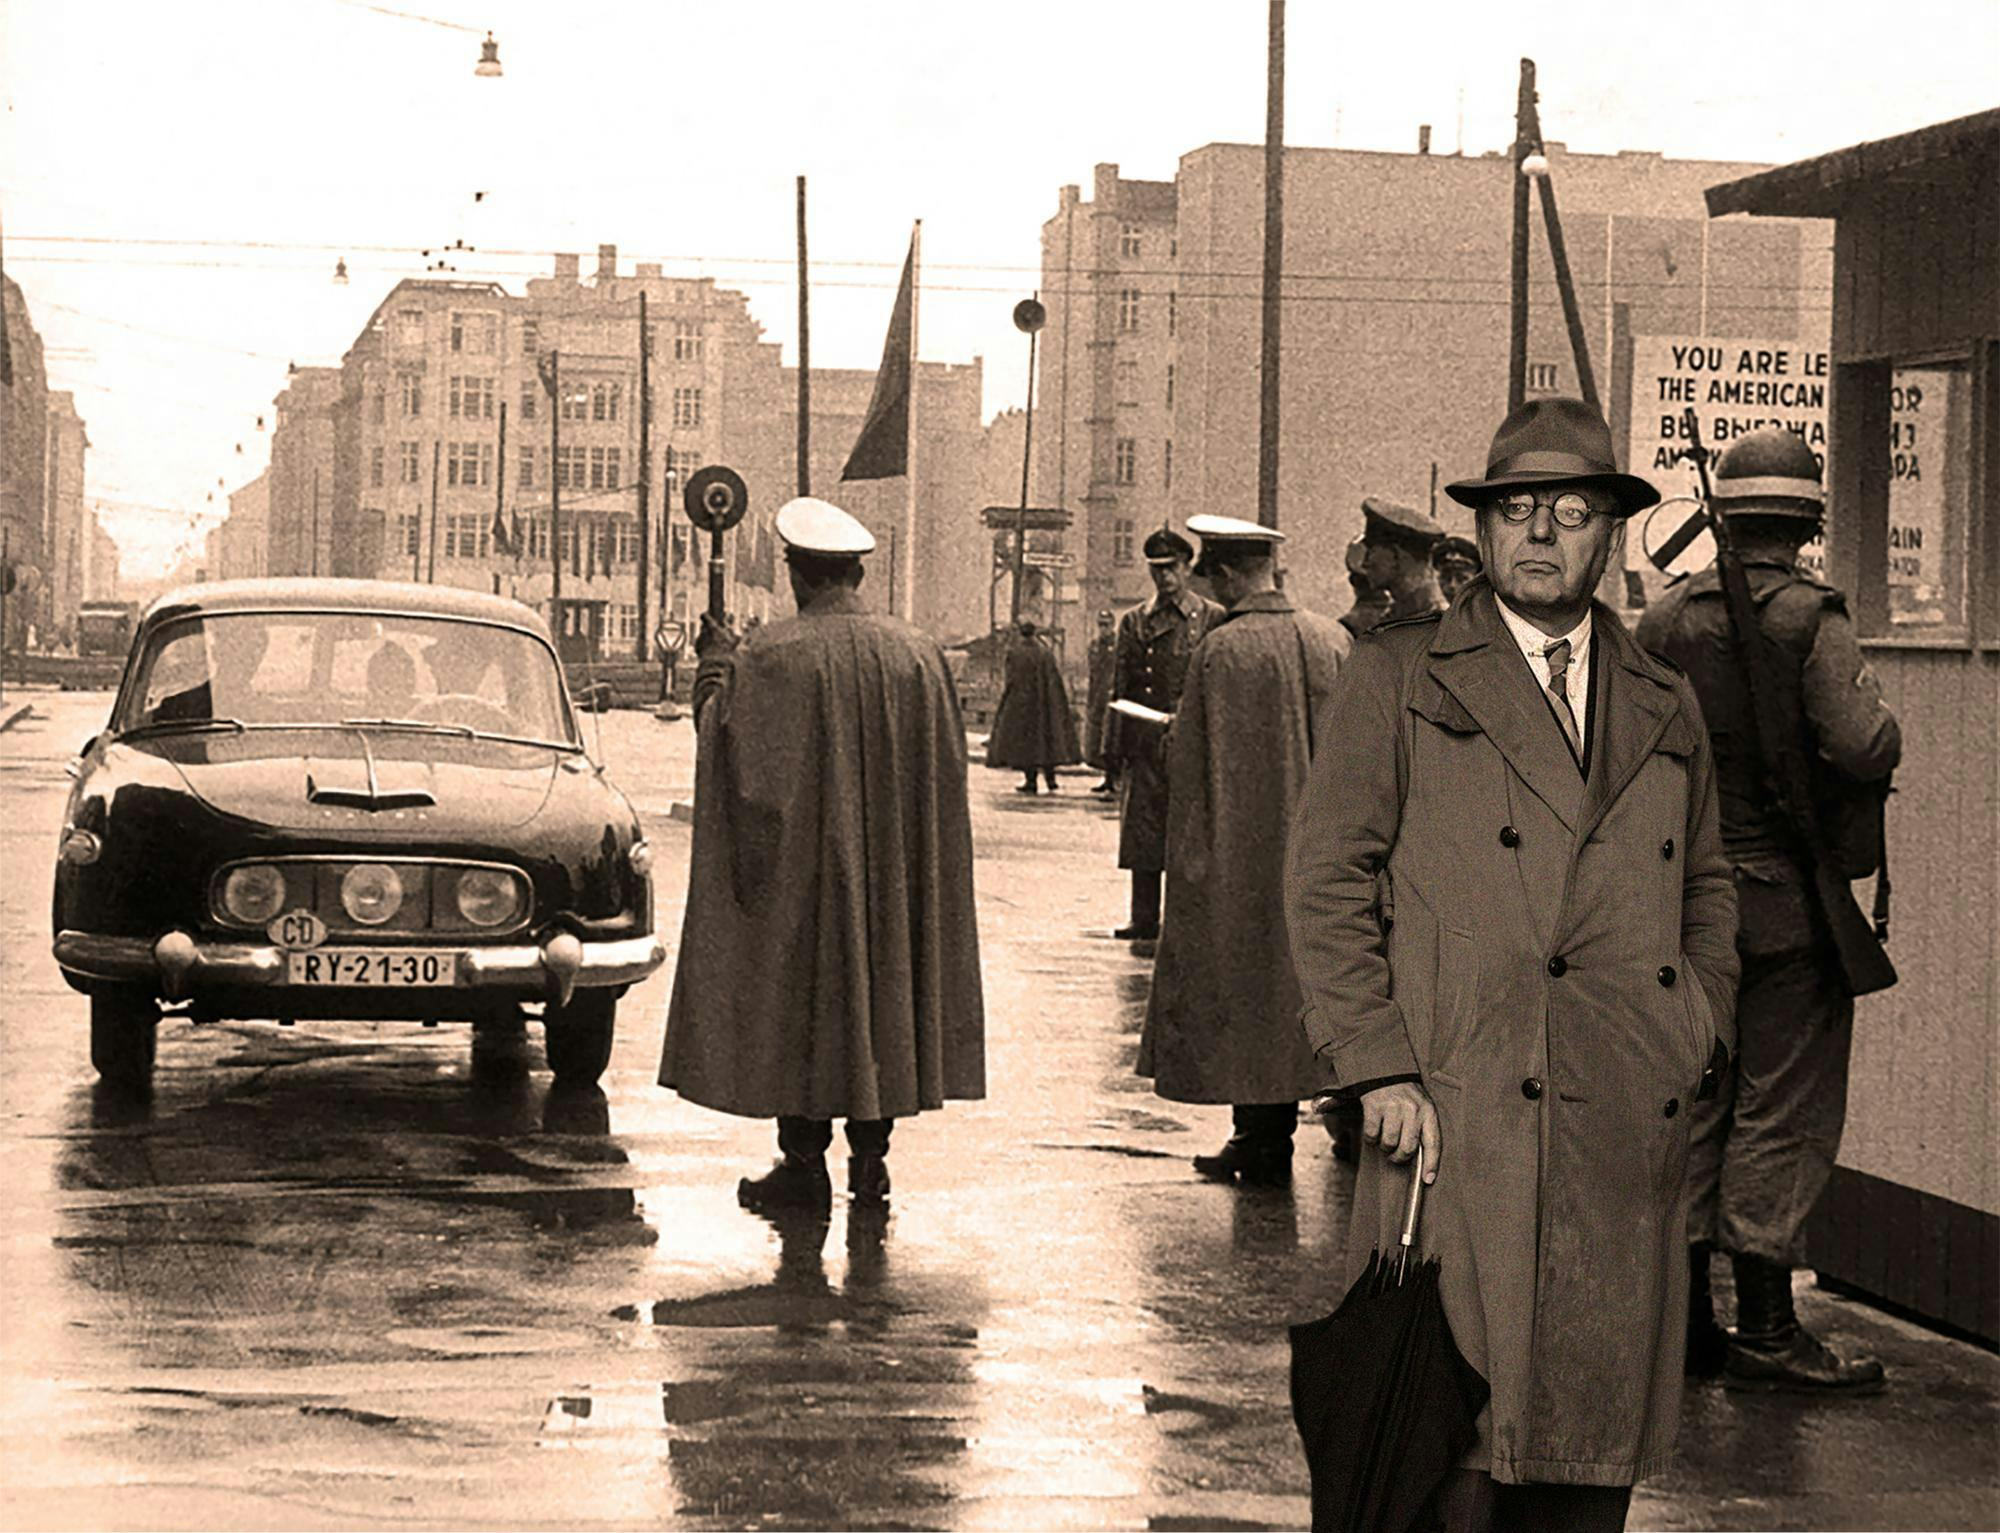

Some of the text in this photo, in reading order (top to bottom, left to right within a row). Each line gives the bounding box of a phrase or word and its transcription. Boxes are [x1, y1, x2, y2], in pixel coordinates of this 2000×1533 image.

[1672, 345, 1722, 371] YOU
[1737, 350, 1788, 375] ARE
[1657, 377, 1696, 402] THE
[1707, 379, 1824, 408] AMERICAN
[283, 916, 313, 945] CD
[305, 955, 438, 984] RY-21-30
